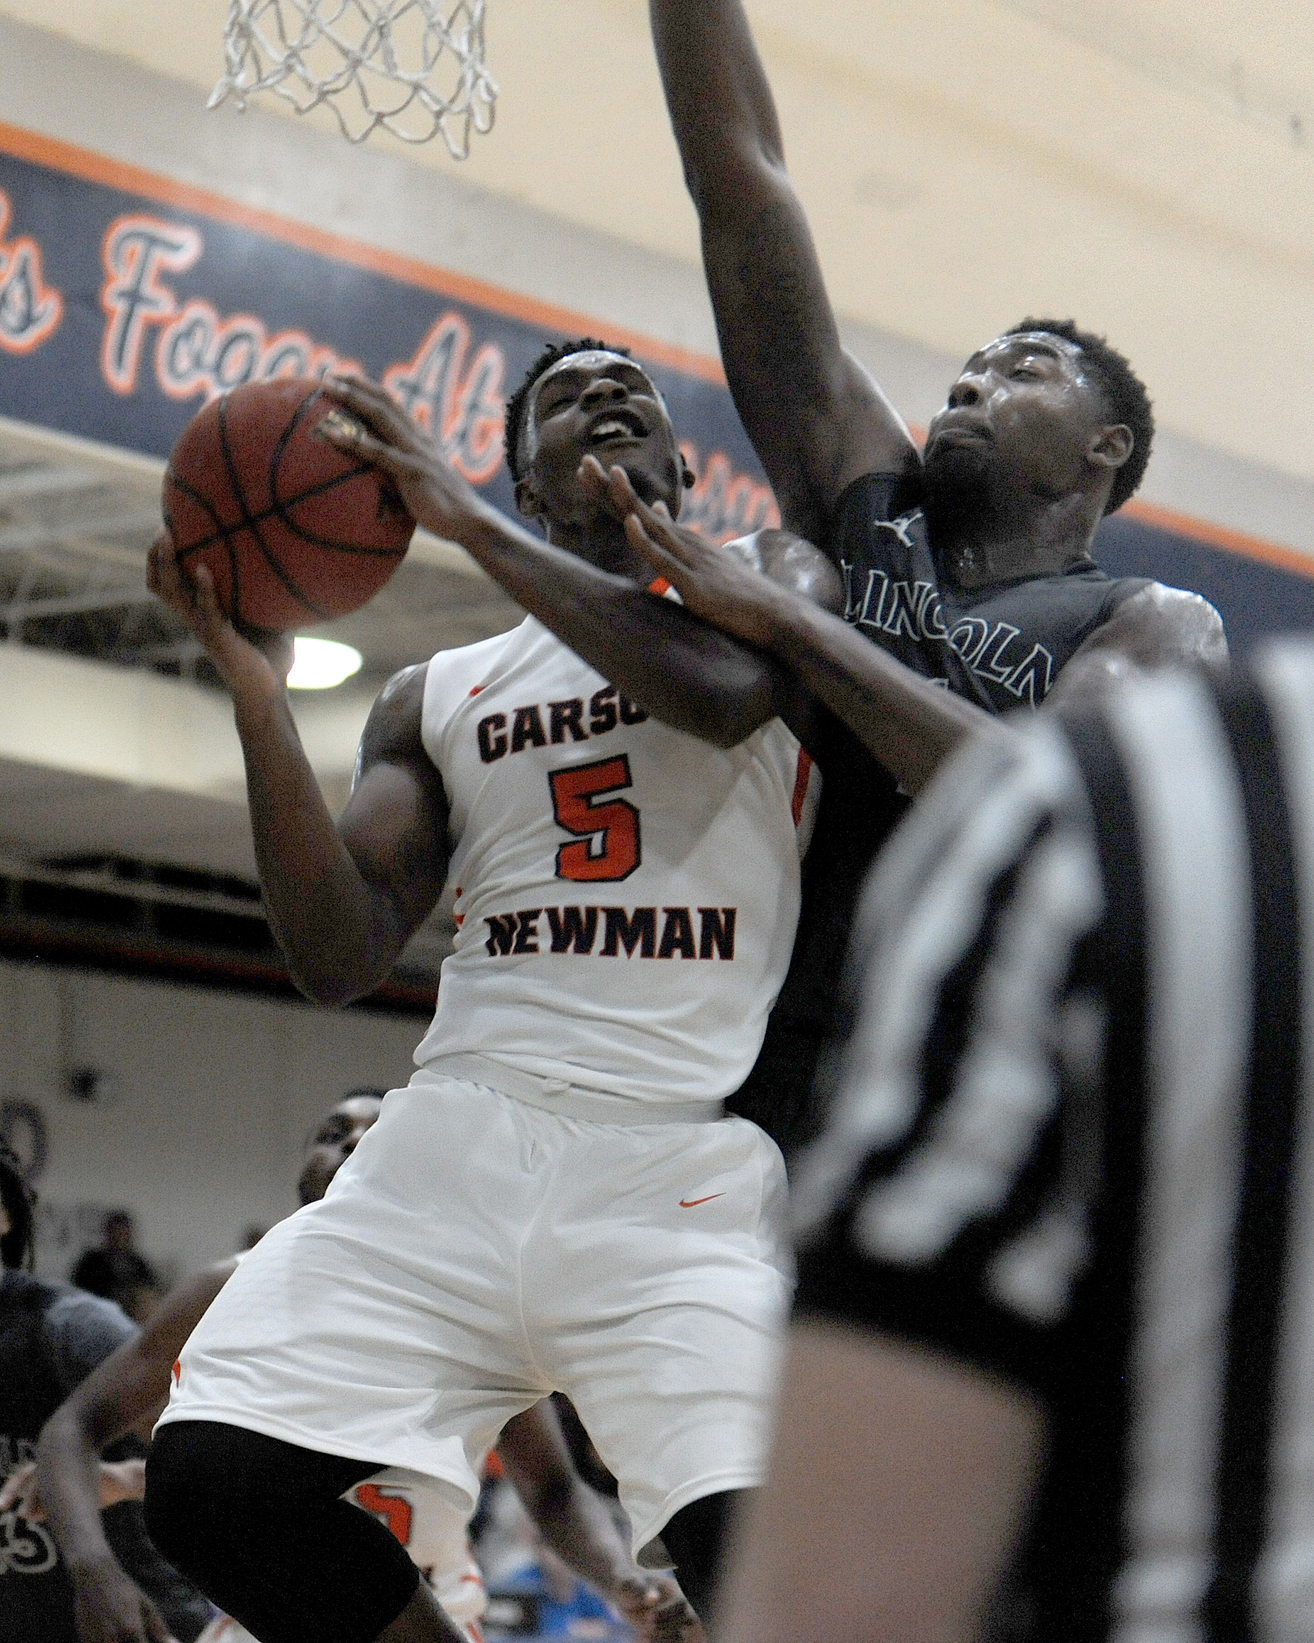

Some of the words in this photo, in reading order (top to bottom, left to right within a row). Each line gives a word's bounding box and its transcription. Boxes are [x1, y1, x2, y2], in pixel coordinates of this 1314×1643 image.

[382, 310, 506, 487] At
[548, 752, 643, 883] 5
[483, 905, 738, 961] NEWMAN
